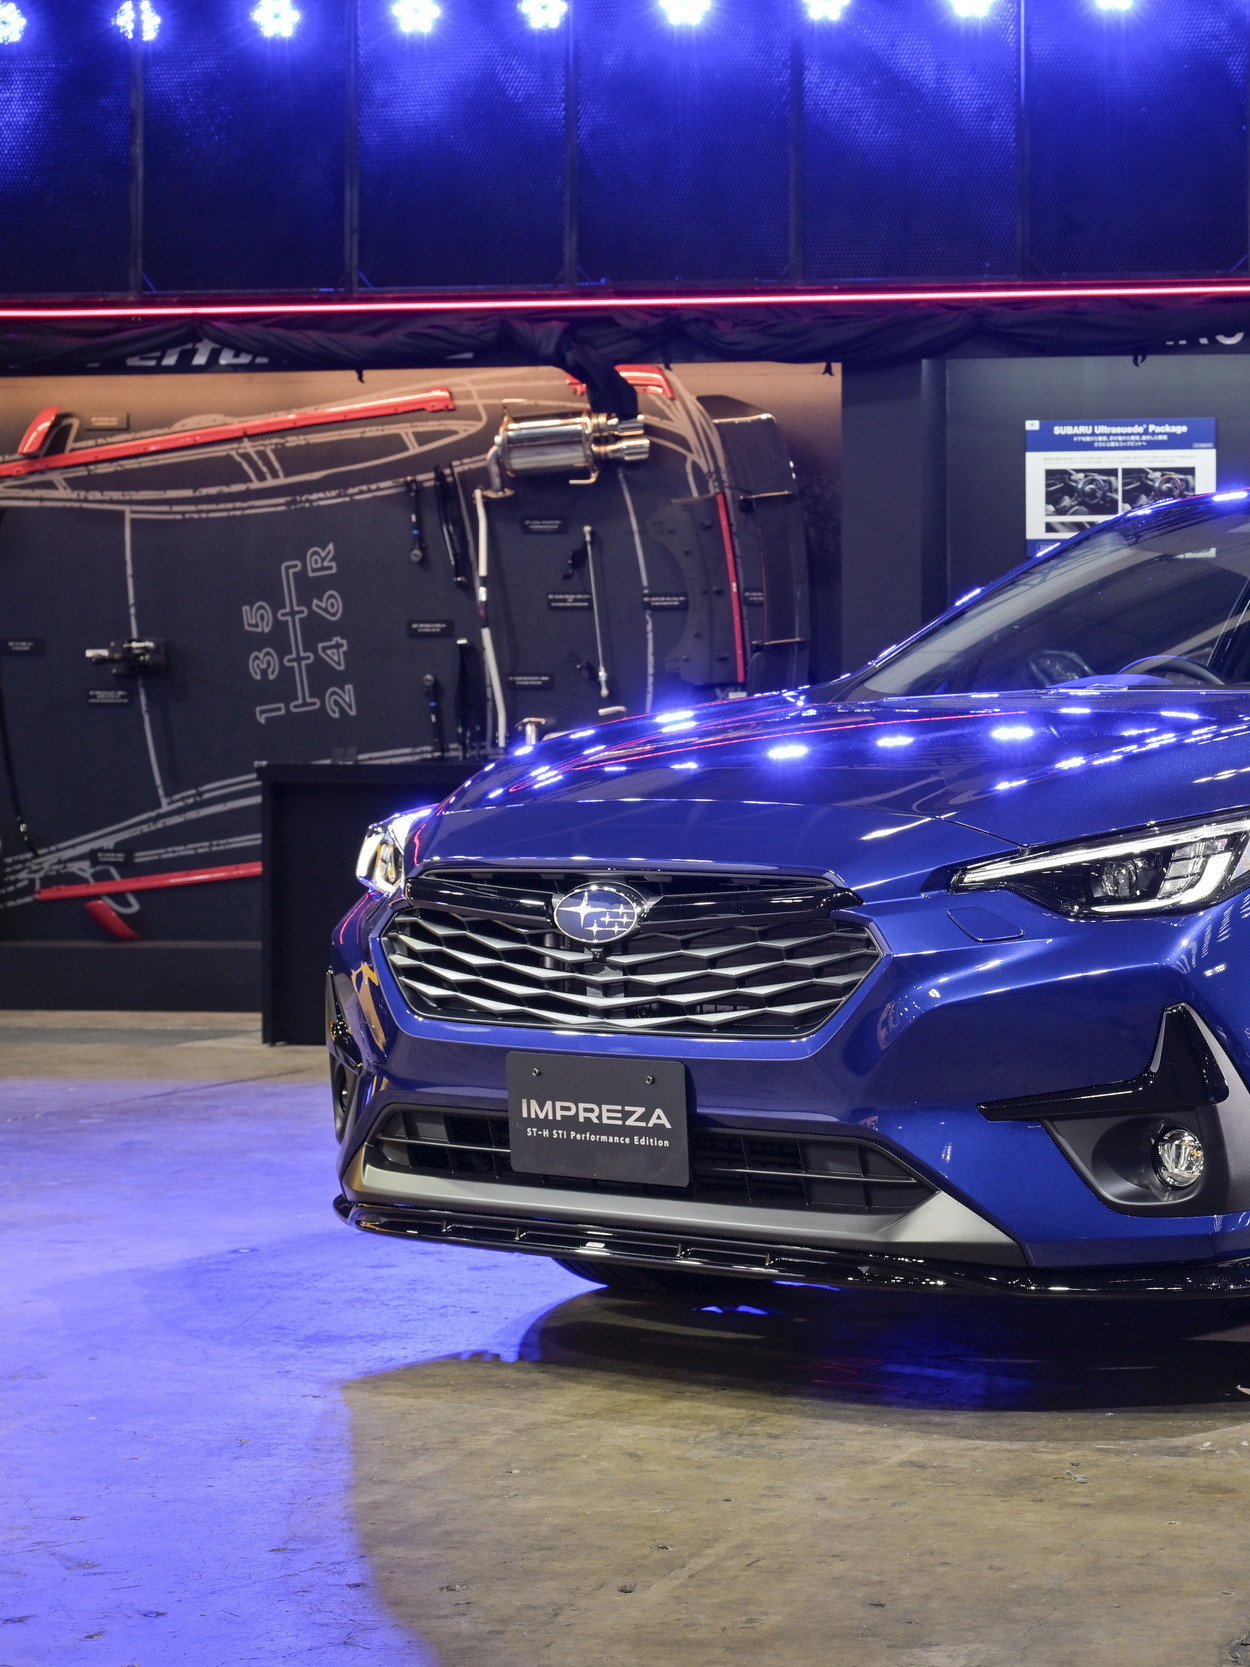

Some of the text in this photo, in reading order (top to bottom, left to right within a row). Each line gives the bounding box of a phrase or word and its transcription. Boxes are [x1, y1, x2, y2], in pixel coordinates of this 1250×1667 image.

[1053, 425, 1093, 435] SUBARU
[1148, 423, 1188, 435] Package
[306, 541, 357, 719] 2 4 6 R
[241, 600, 286, 726] 1 3 5
[521, 1097, 673, 1129] IMPREZA
[526, 1127, 670, 1148] ST-H STI Performance Edition
